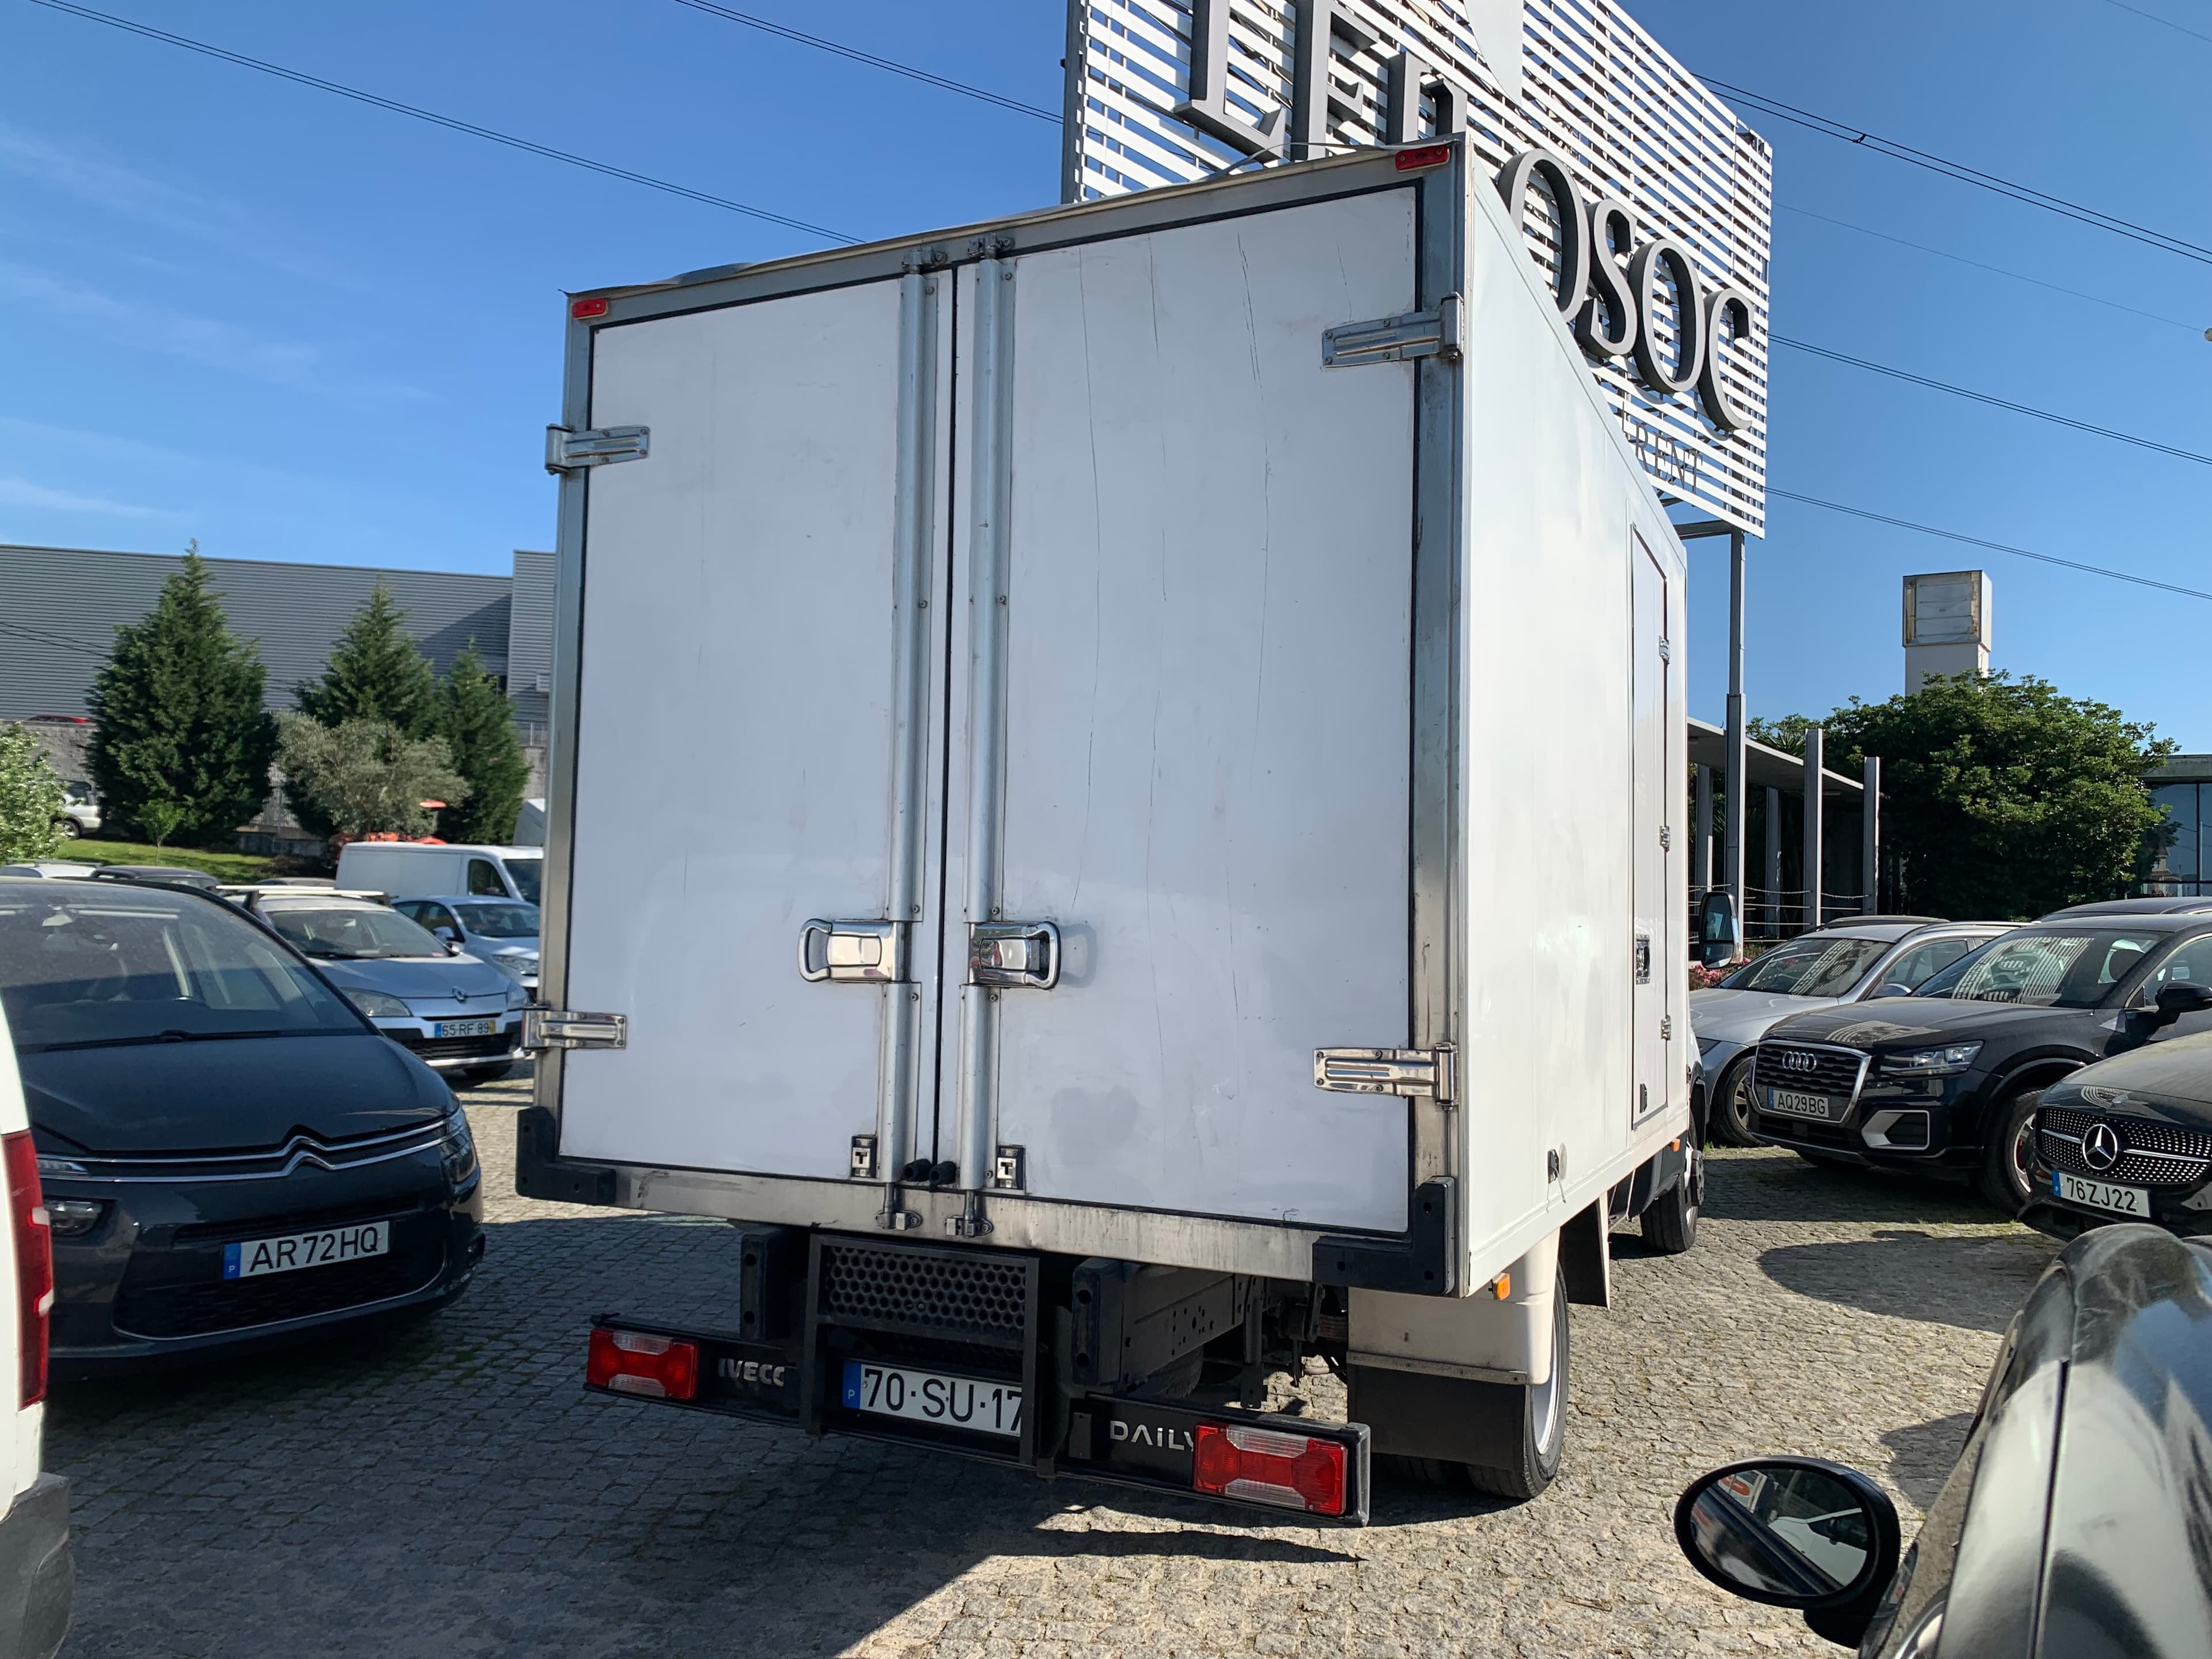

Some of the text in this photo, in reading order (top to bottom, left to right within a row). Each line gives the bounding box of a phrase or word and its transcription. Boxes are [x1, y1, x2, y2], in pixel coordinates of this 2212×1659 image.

[1778, 1092, 1825, 1114] AQ29BG
[2066, 1177, 2137, 1212] 76ZJ22
[249, 1226, 378, 1272] AR72HQ
[847, 1389, 855, 1399] P
